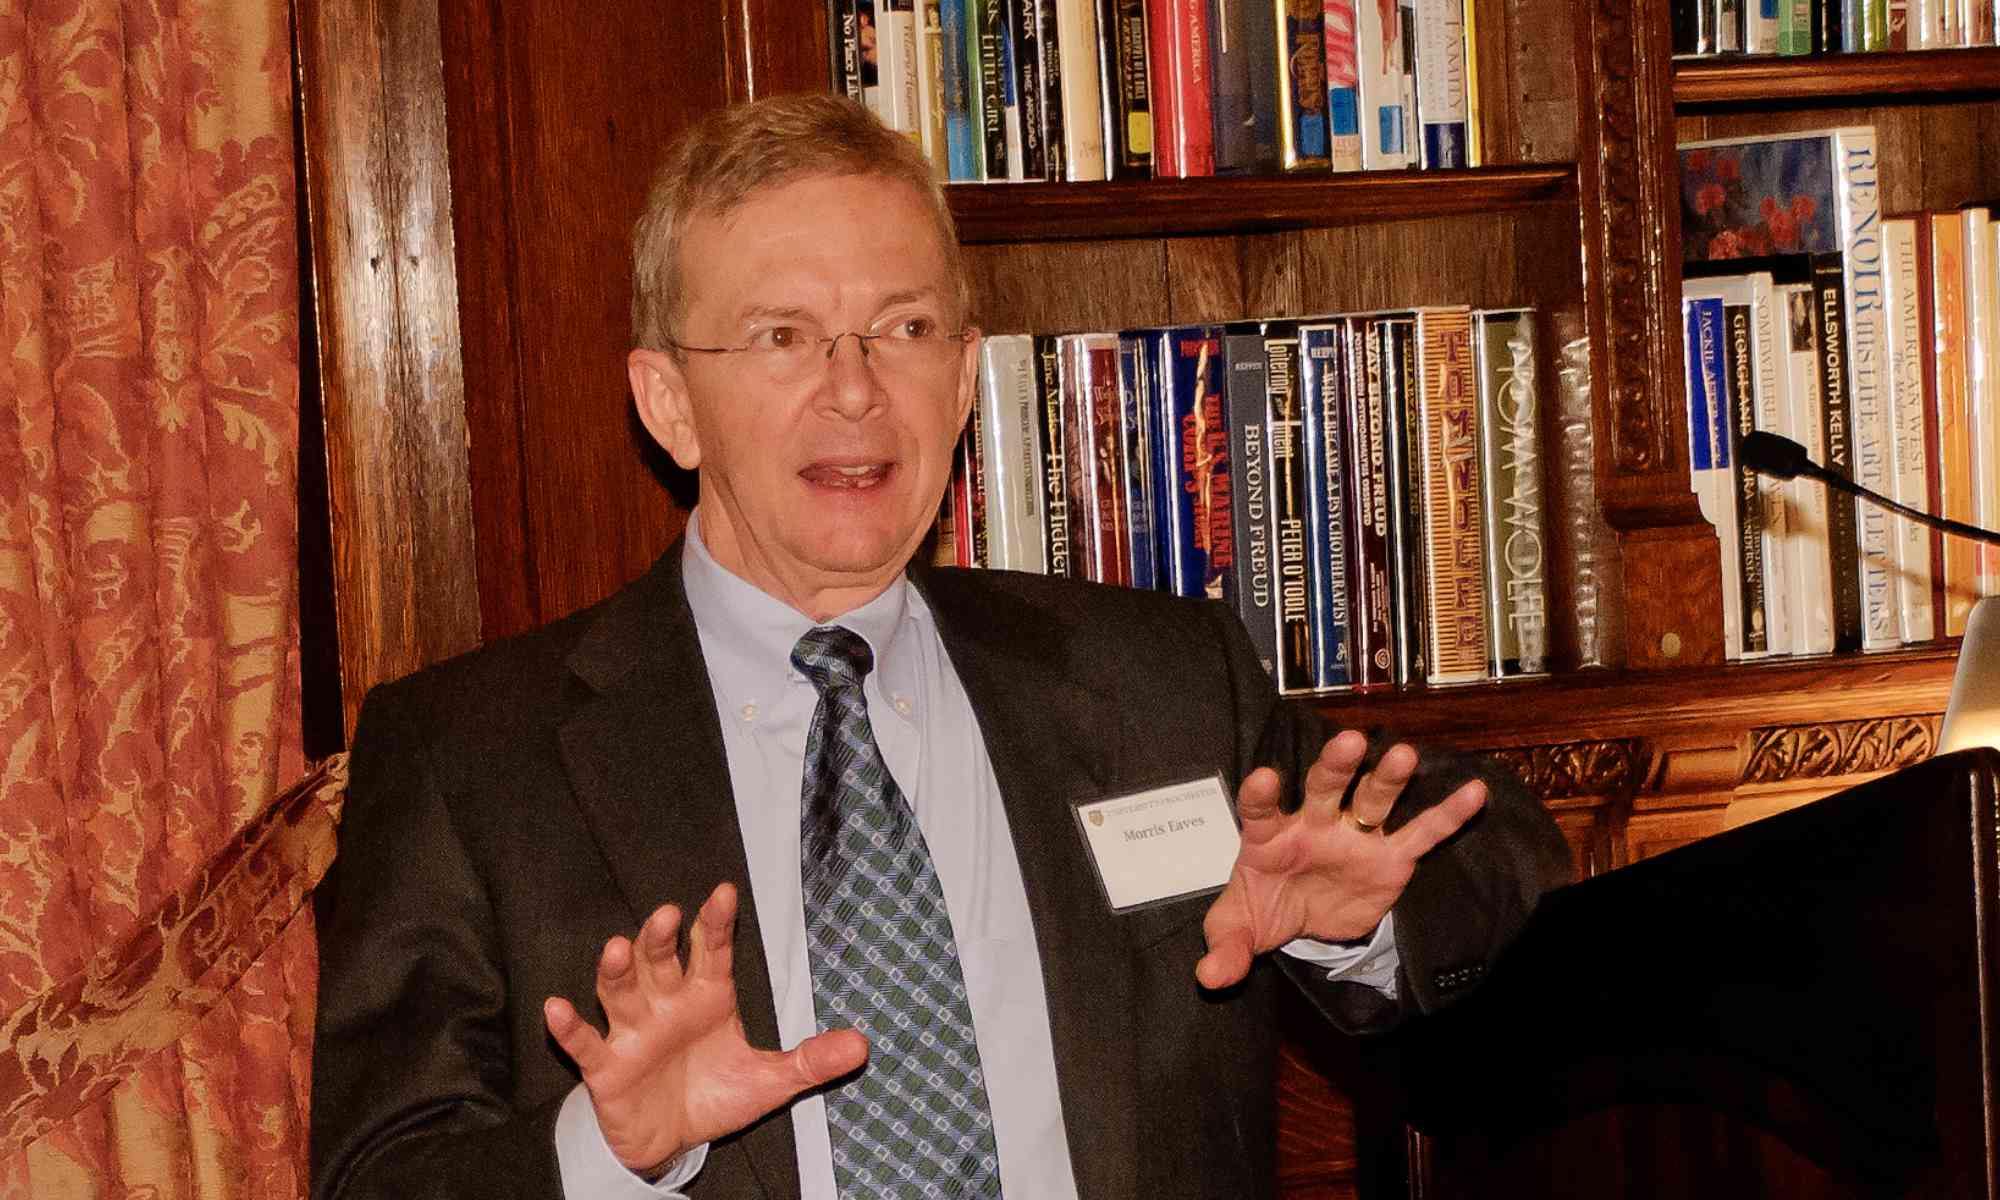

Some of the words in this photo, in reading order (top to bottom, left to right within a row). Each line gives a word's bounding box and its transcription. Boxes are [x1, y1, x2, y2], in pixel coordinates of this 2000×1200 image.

[843, 13, 855, 36] No
[1190, 15, 1202, 85] AMERICA
[844, 38, 857, 73] Place
[982, 34, 997, 90] LITTLE
[1023, 64, 1034, 92] TIME
[846, 74, 859, 99] Lik
[985, 94, 999, 138] GIRL
[1025, 96, 1038, 149] AROUND
[1847, 147, 1884, 316] RENOIR
[1900, 237, 1914, 281] THE
[1365, 332, 1379, 377] WAY
[1701, 311, 1716, 363] JACKIE
[1733, 313, 1750, 391] GEORGE
[1757, 295, 1777, 417] SOMEWHERE
[1822, 287, 1843, 405] ELLSWORTH
[1855, 320, 1880, 363] HIS
[1894, 350, 1905, 374] The
[1901, 286, 1922, 407] AMERICAN
[1041, 351, 1058, 384] Jane
[1264, 338, 1300, 395] Loitering
[1323, 371, 1337, 408] WHY
[1368, 382, 1382, 466] BEYOND
[1497, 347, 1537, 471] TOM
[1895, 379, 1907, 430] Modern
[1270, 421, 1302, 459] Intent
[1326, 419, 1340, 476] BECAME
[1829, 409, 1846, 467] KELLY
[1896, 436, 1909, 475] Vision
[1909, 415, 1924, 474] WEST
[1047, 452, 1065, 494] The
[1244, 423, 1264, 521] BEYOND
[1212, 472, 1233, 569] MARINE
[1373, 471, 1387, 537] FREUD
[1250, 526, 1270, 608] FREUD
[1280, 519, 1305, 564] PETER
[1329, 495, 1347, 627] PSYCHOTHERAPIST
[1503, 489, 1545, 631] WOLFE
[1743, 518, 1757, 583] ANDERSEN
[1282, 565, 1308, 624] O'TOOLE
[1123, 824, 1166, 842] Morris
[1167, 817, 1205, 833] Eaves
